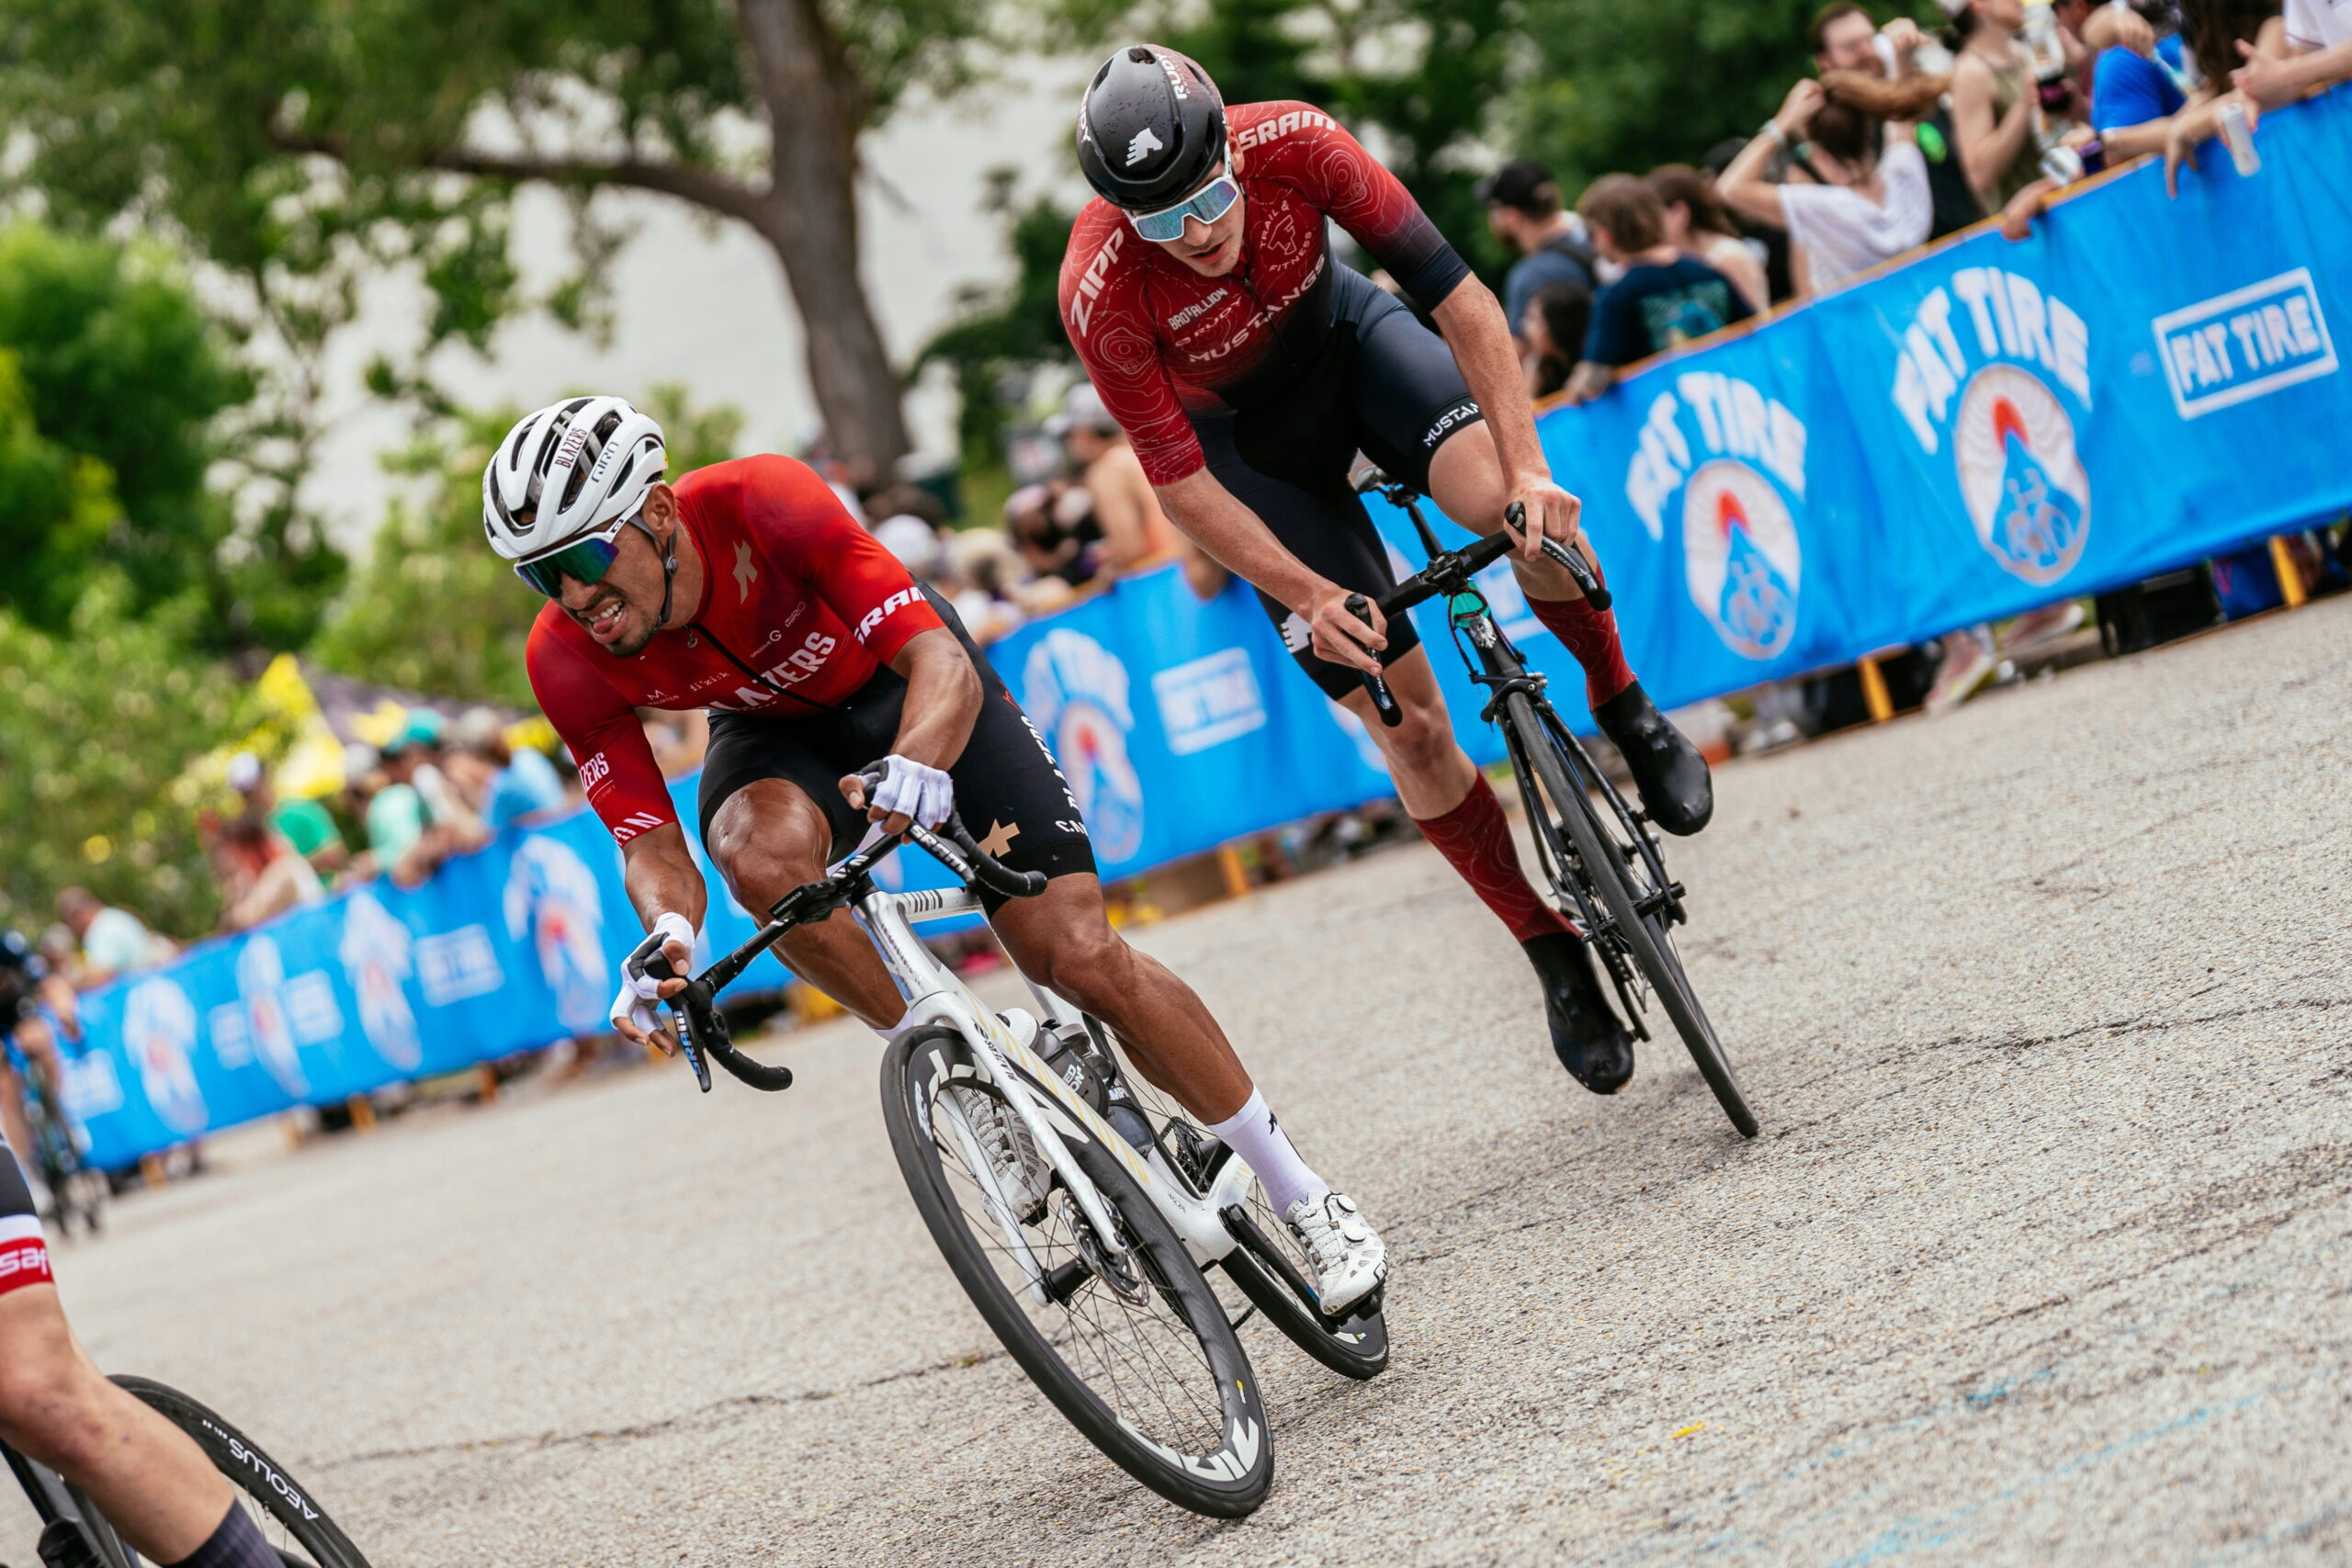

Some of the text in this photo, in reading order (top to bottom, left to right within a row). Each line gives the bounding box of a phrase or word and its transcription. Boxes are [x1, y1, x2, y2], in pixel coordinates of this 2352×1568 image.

[1156, 52, 1188, 100] RUDY
[1238, 110, 1336, 152] SRAM
[1260, 199, 1290, 250] TRAIL &
[1269, 231, 1312, 273] FITNESS
[1070, 226, 1125, 338] ZIPP
[1167, 287, 1229, 331] BROTALLION
[1189, 253, 1325, 362] MUSTANGS
[1193, 296, 1242, 337] RUDY
[1892, 285, 1967, 457] FAT
[1951, 266, 2093, 413] TIRE
[2169, 294, 2321, 393] FAT TIRE
[554, 426, 588, 469] BLAZERS
[590, 441, 619, 483] GIRO
[1625, 370, 1807, 542] FAT TIRE
[709, 631, 837, 711] LAZERS
[580, 751, 610, 793] ZERS
[910, 823, 967, 873] SRAM
[228, 1437, 318, 1521] AEOLUS
